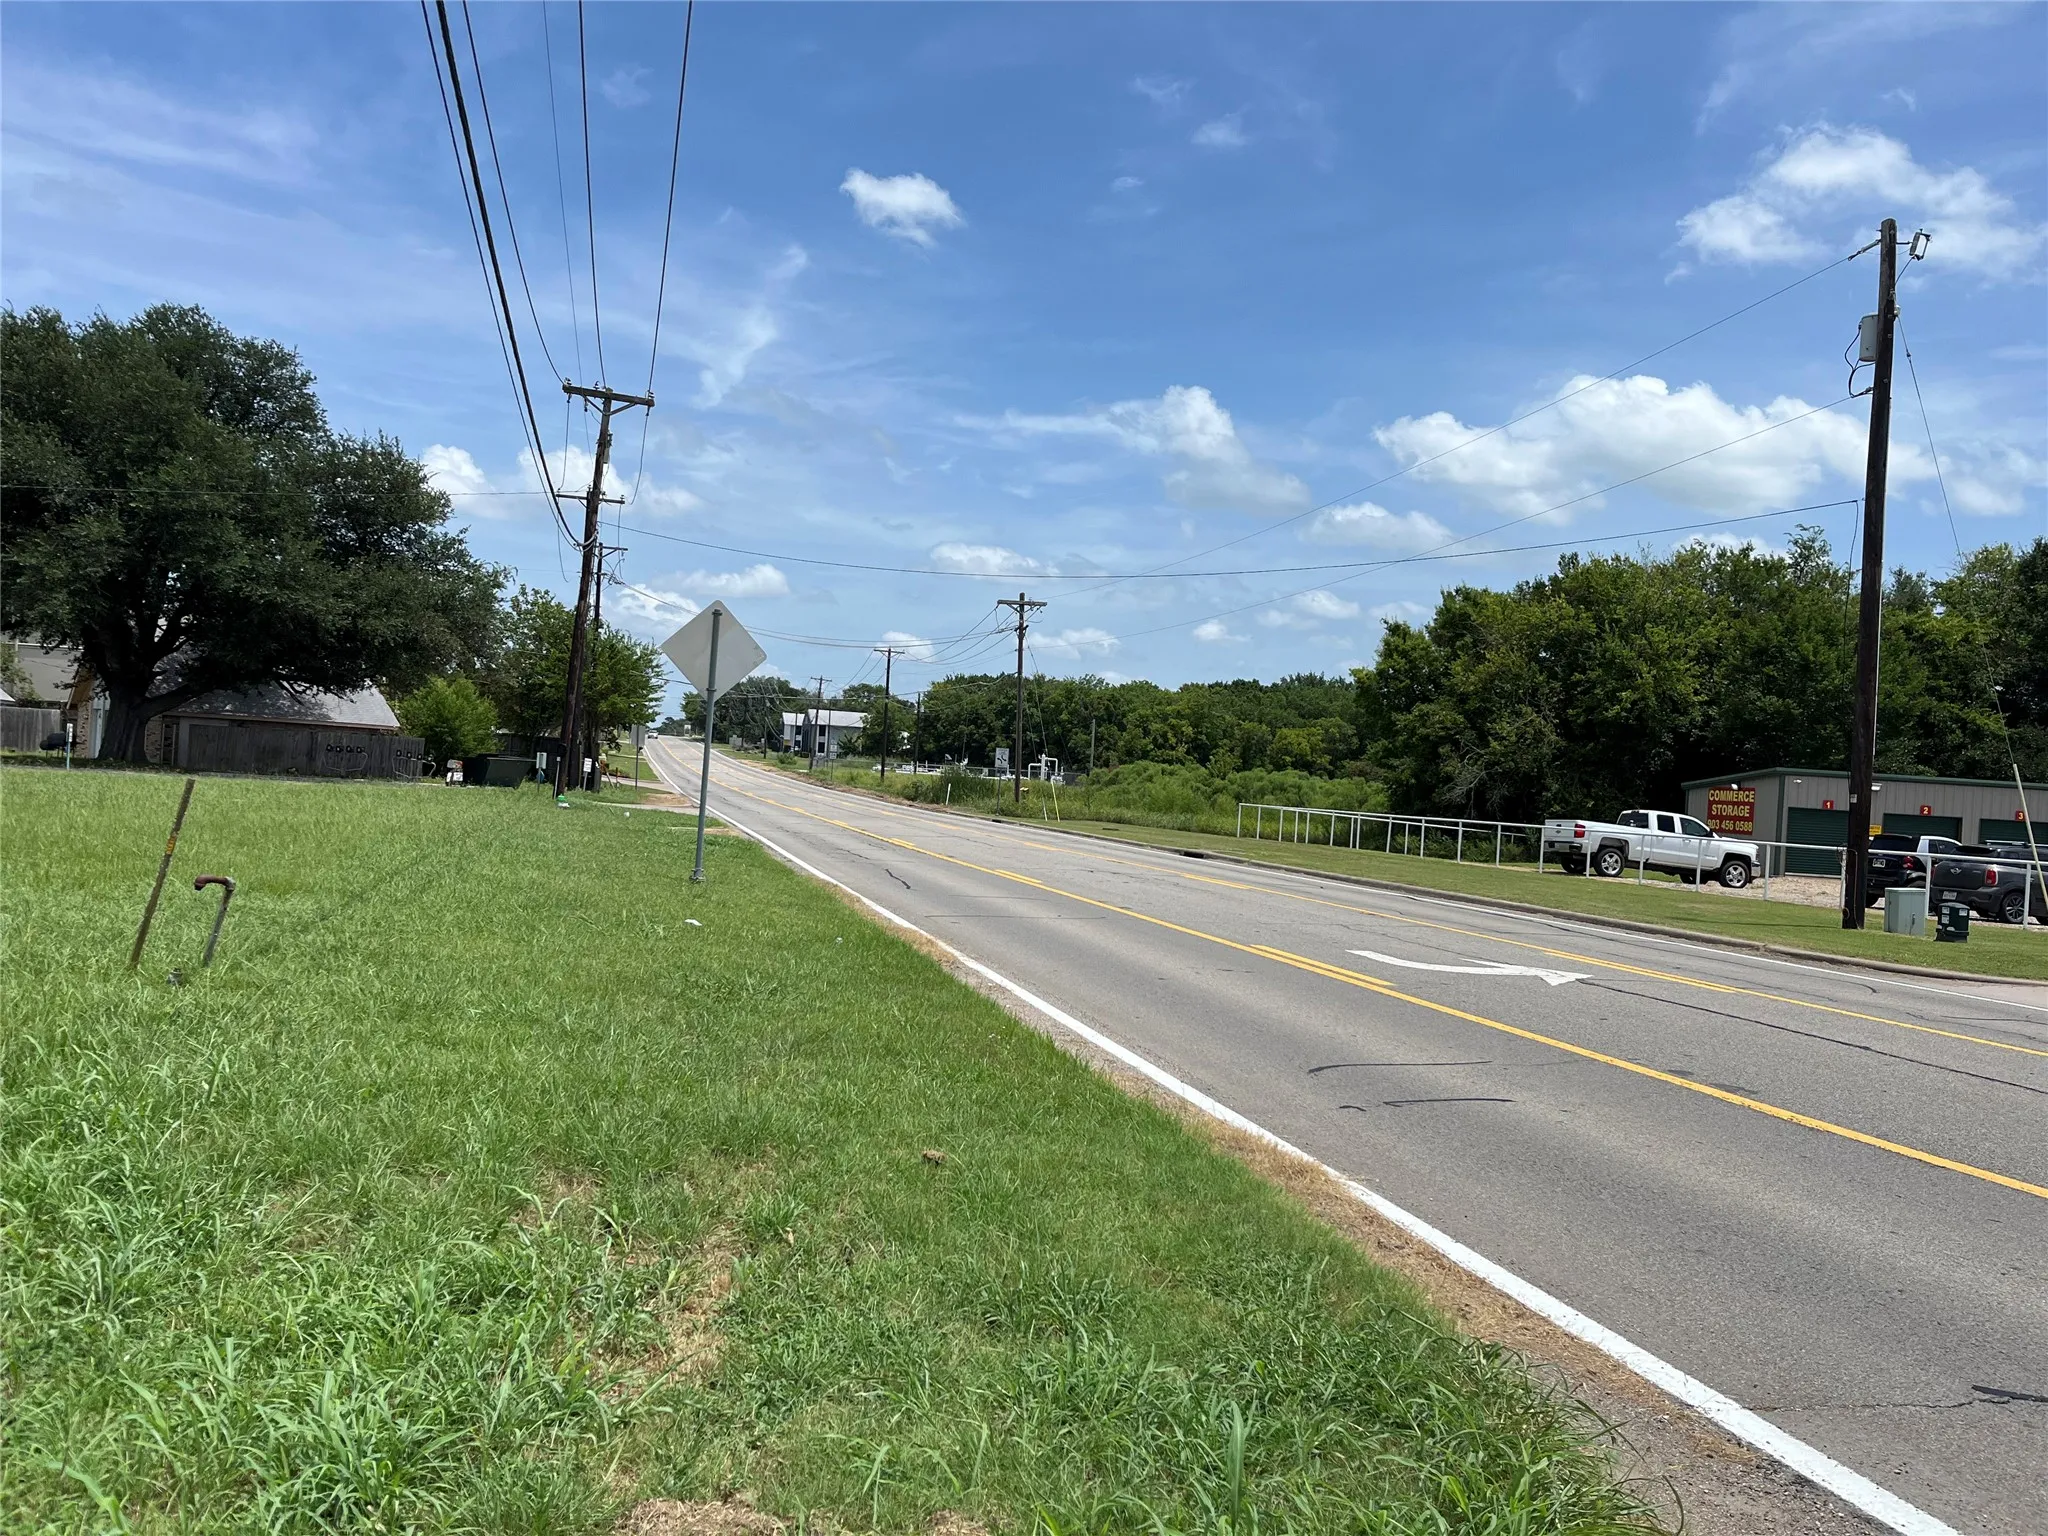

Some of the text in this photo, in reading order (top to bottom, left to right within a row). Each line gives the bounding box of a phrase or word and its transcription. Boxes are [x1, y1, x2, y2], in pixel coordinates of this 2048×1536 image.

[1709, 790, 1754, 802] COMMERCE
[1712, 804, 1750, 816] STORAGE
[1826, 801, 1831, 809] 1
[1923, 806, 1929, 814] 2
[1707, 819, 1752, 832] 903 456 0588
